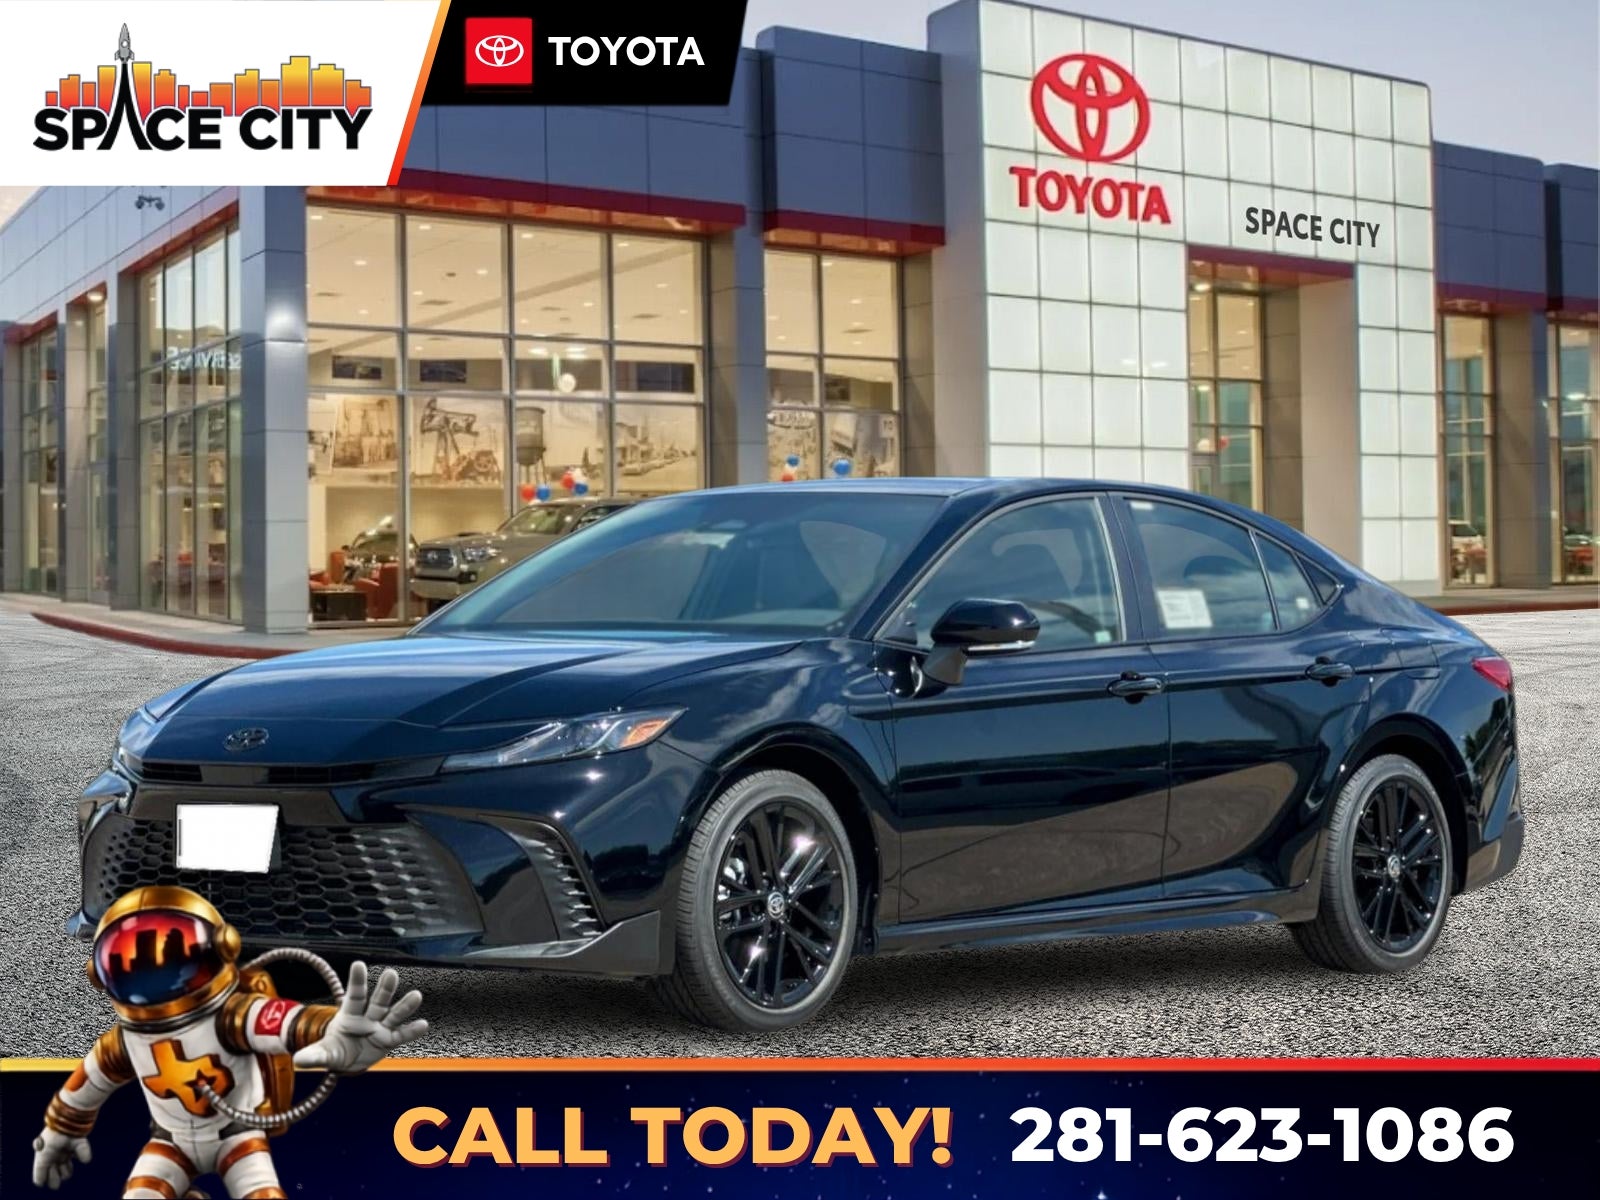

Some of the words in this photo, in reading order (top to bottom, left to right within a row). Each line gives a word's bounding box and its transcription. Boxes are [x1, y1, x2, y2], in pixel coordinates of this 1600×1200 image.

[1009, 165, 1172, 225] TOYOTA
[1245, 206, 1323, 242] SPACE
[1328, 217, 1381, 249] CITY
